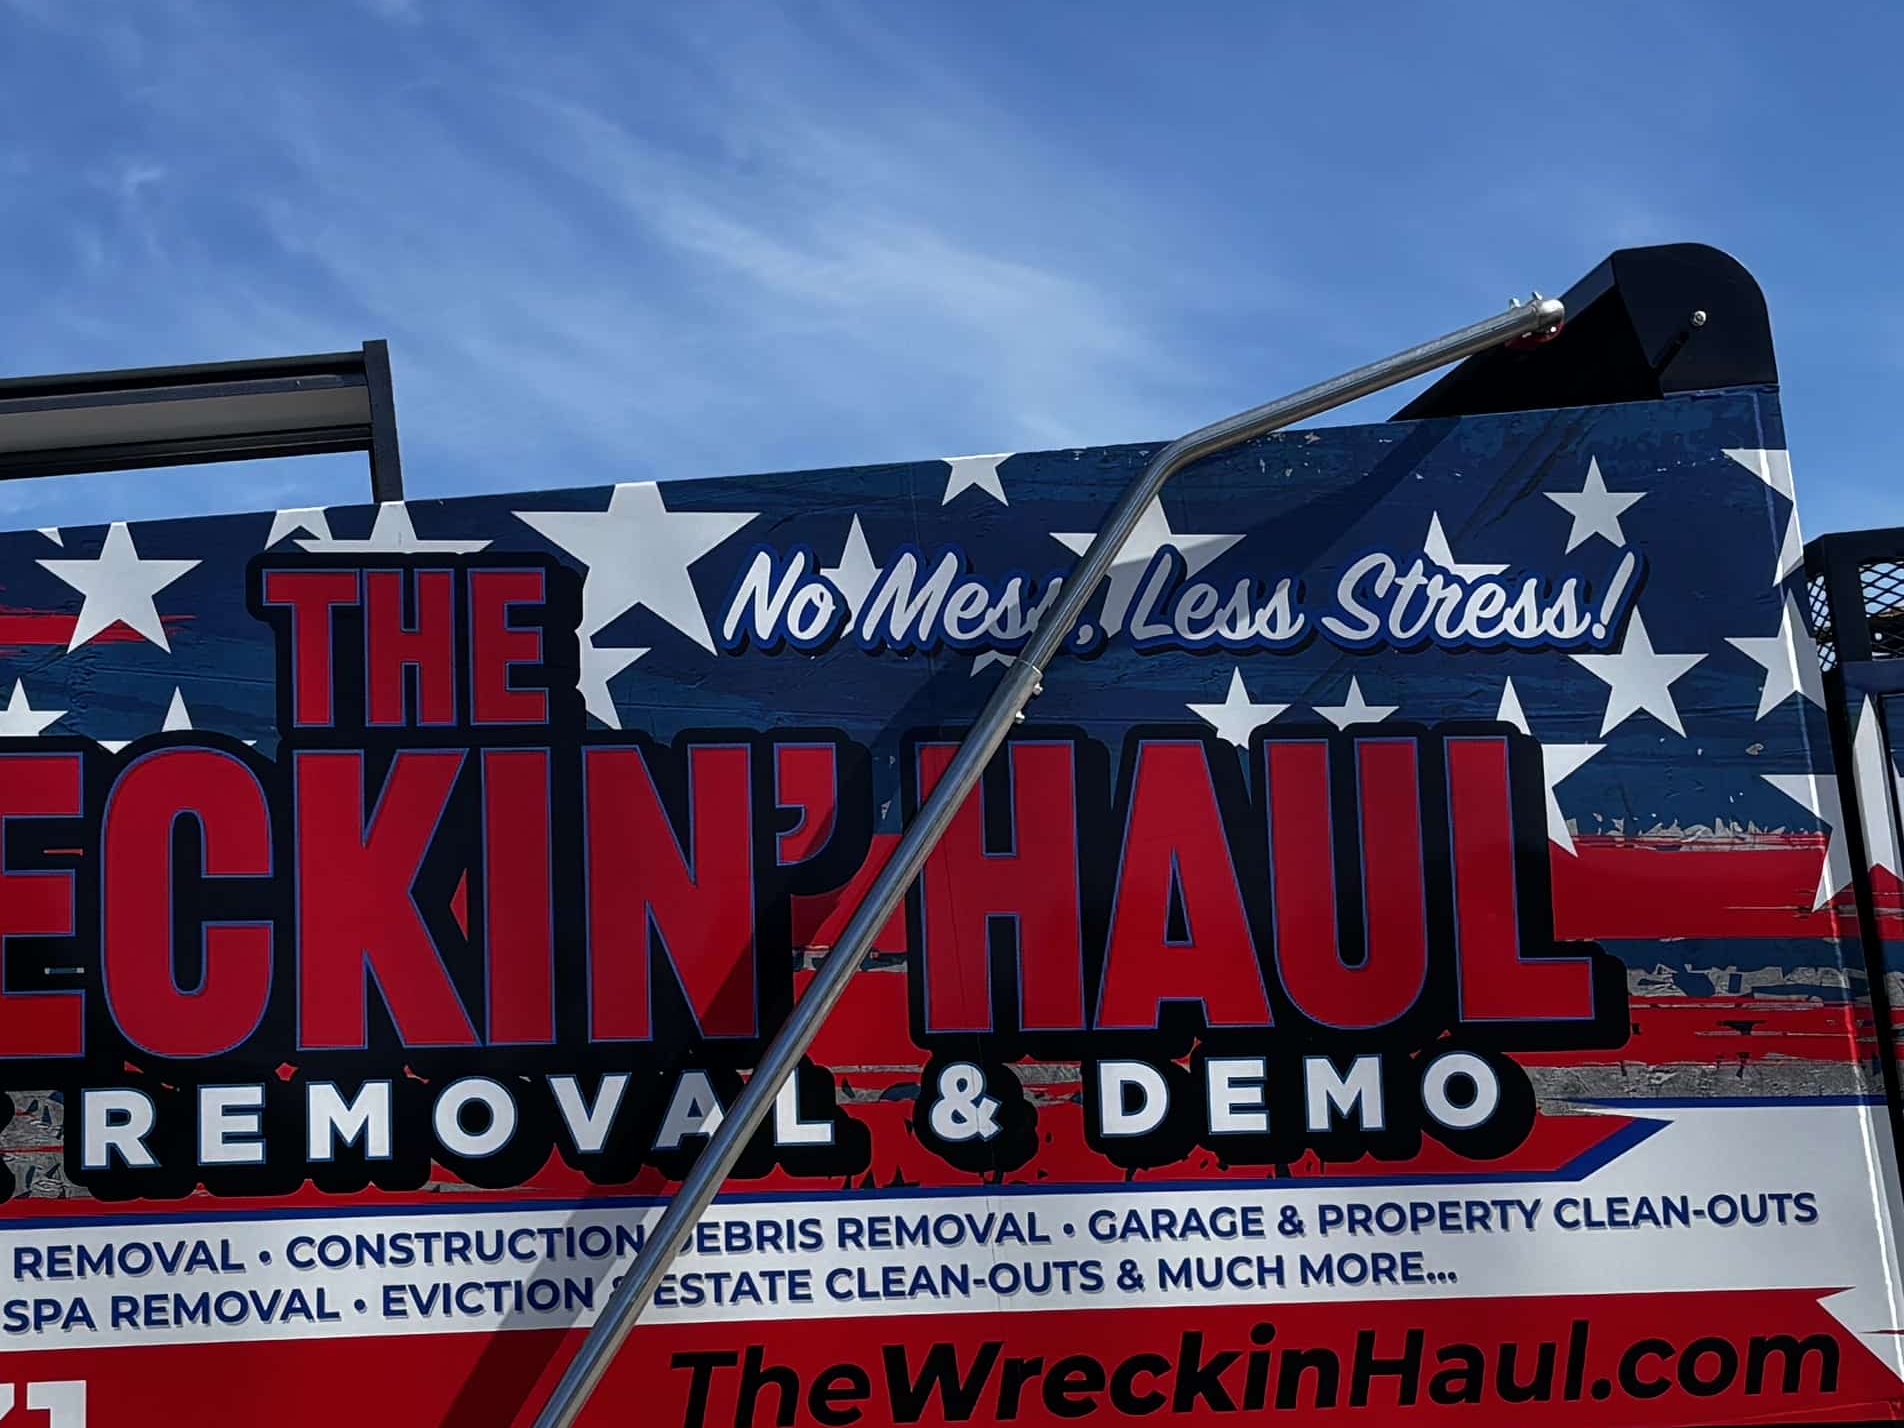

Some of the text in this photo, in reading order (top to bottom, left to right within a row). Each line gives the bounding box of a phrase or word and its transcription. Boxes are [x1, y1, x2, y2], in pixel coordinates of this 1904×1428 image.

[262, 566, 549, 728] THE
[723, 547, 1636, 645] No Mes, Less Stress!
[914, 733, 1596, 1037] HAUL
[80, 1066, 835, 1170] REMOVAL
[929, 1060, 1003, 1143] &
[1099, 1049, 1502, 1143] DEMO
[14, 1236, 245, 1282] REMOVAL
[285, 1224, 645, 1270] CONSTRUCTION
[678, 1217, 825, 1257] EBRIS
[836, 1208, 1052, 1251] REMOVAL
[1088, 1204, 1266, 1244] GARAGE
[1279, 1204, 1306, 1239] &
[1318, 1196, 1543, 1238] PROPERTY
[1553, 1190, 1819, 1232] CLEAN-OUTS
[3, 1296, 96, 1334] SPA
[110, 1287, 340, 1329] REMOVAL
[382, 1277, 594, 1320] EVICTION
[653, 1269, 813, 1308] ESTATE
[825, 1259, 1102, 1305] CLEAN-OUTS
[1116, 1259, 1144, 1291] &
[1157, 1254, 1284, 1290] MUCH
[1300, 1249, 1457, 1287] MORE...
